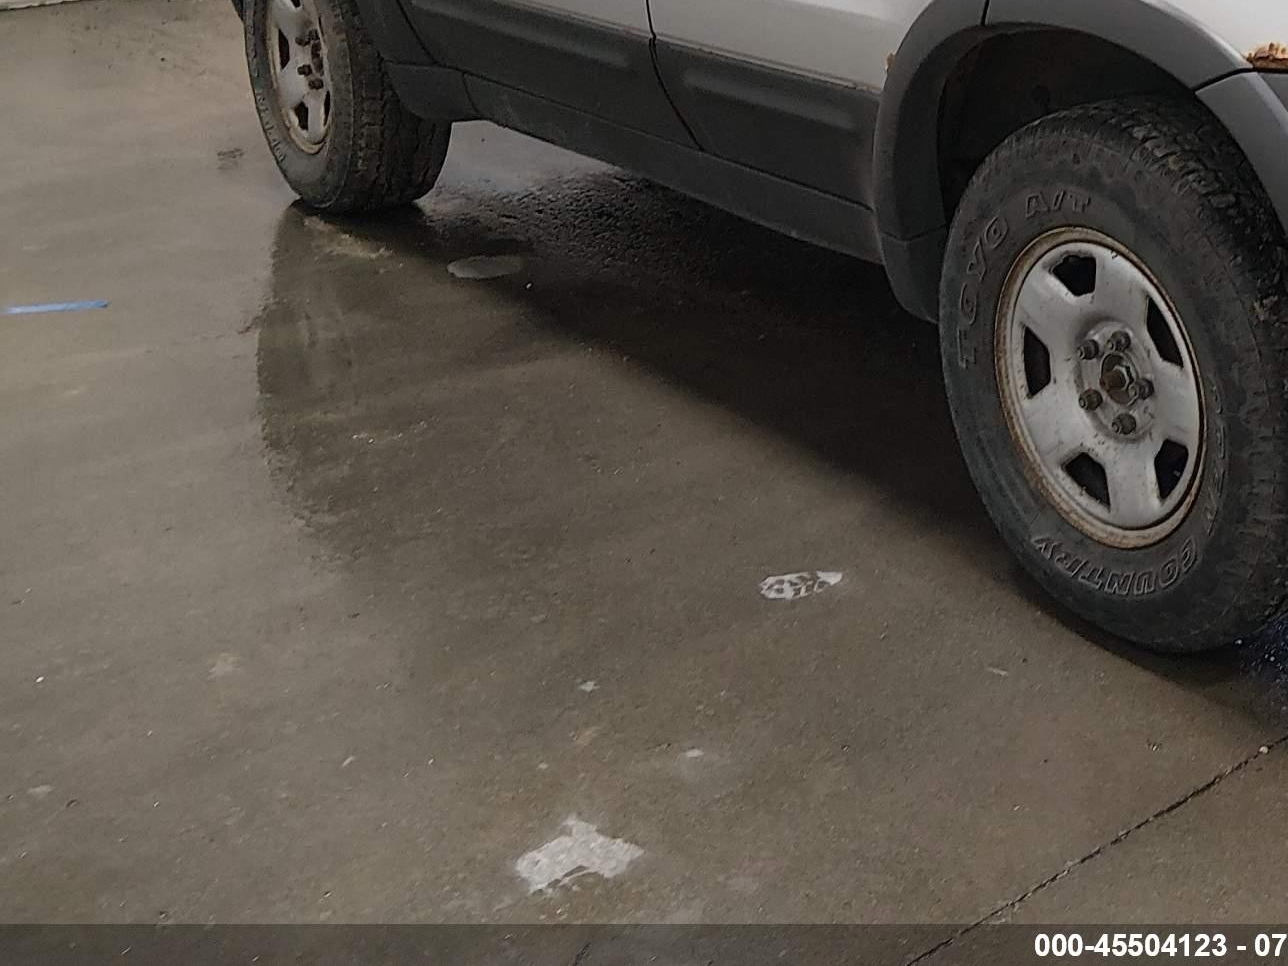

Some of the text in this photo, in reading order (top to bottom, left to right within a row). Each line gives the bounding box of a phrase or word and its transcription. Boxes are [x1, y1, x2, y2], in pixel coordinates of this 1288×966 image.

[957, 189, 1092, 371] TOYO A/T
[1031, 536, 1200, 596] COUNTRY
